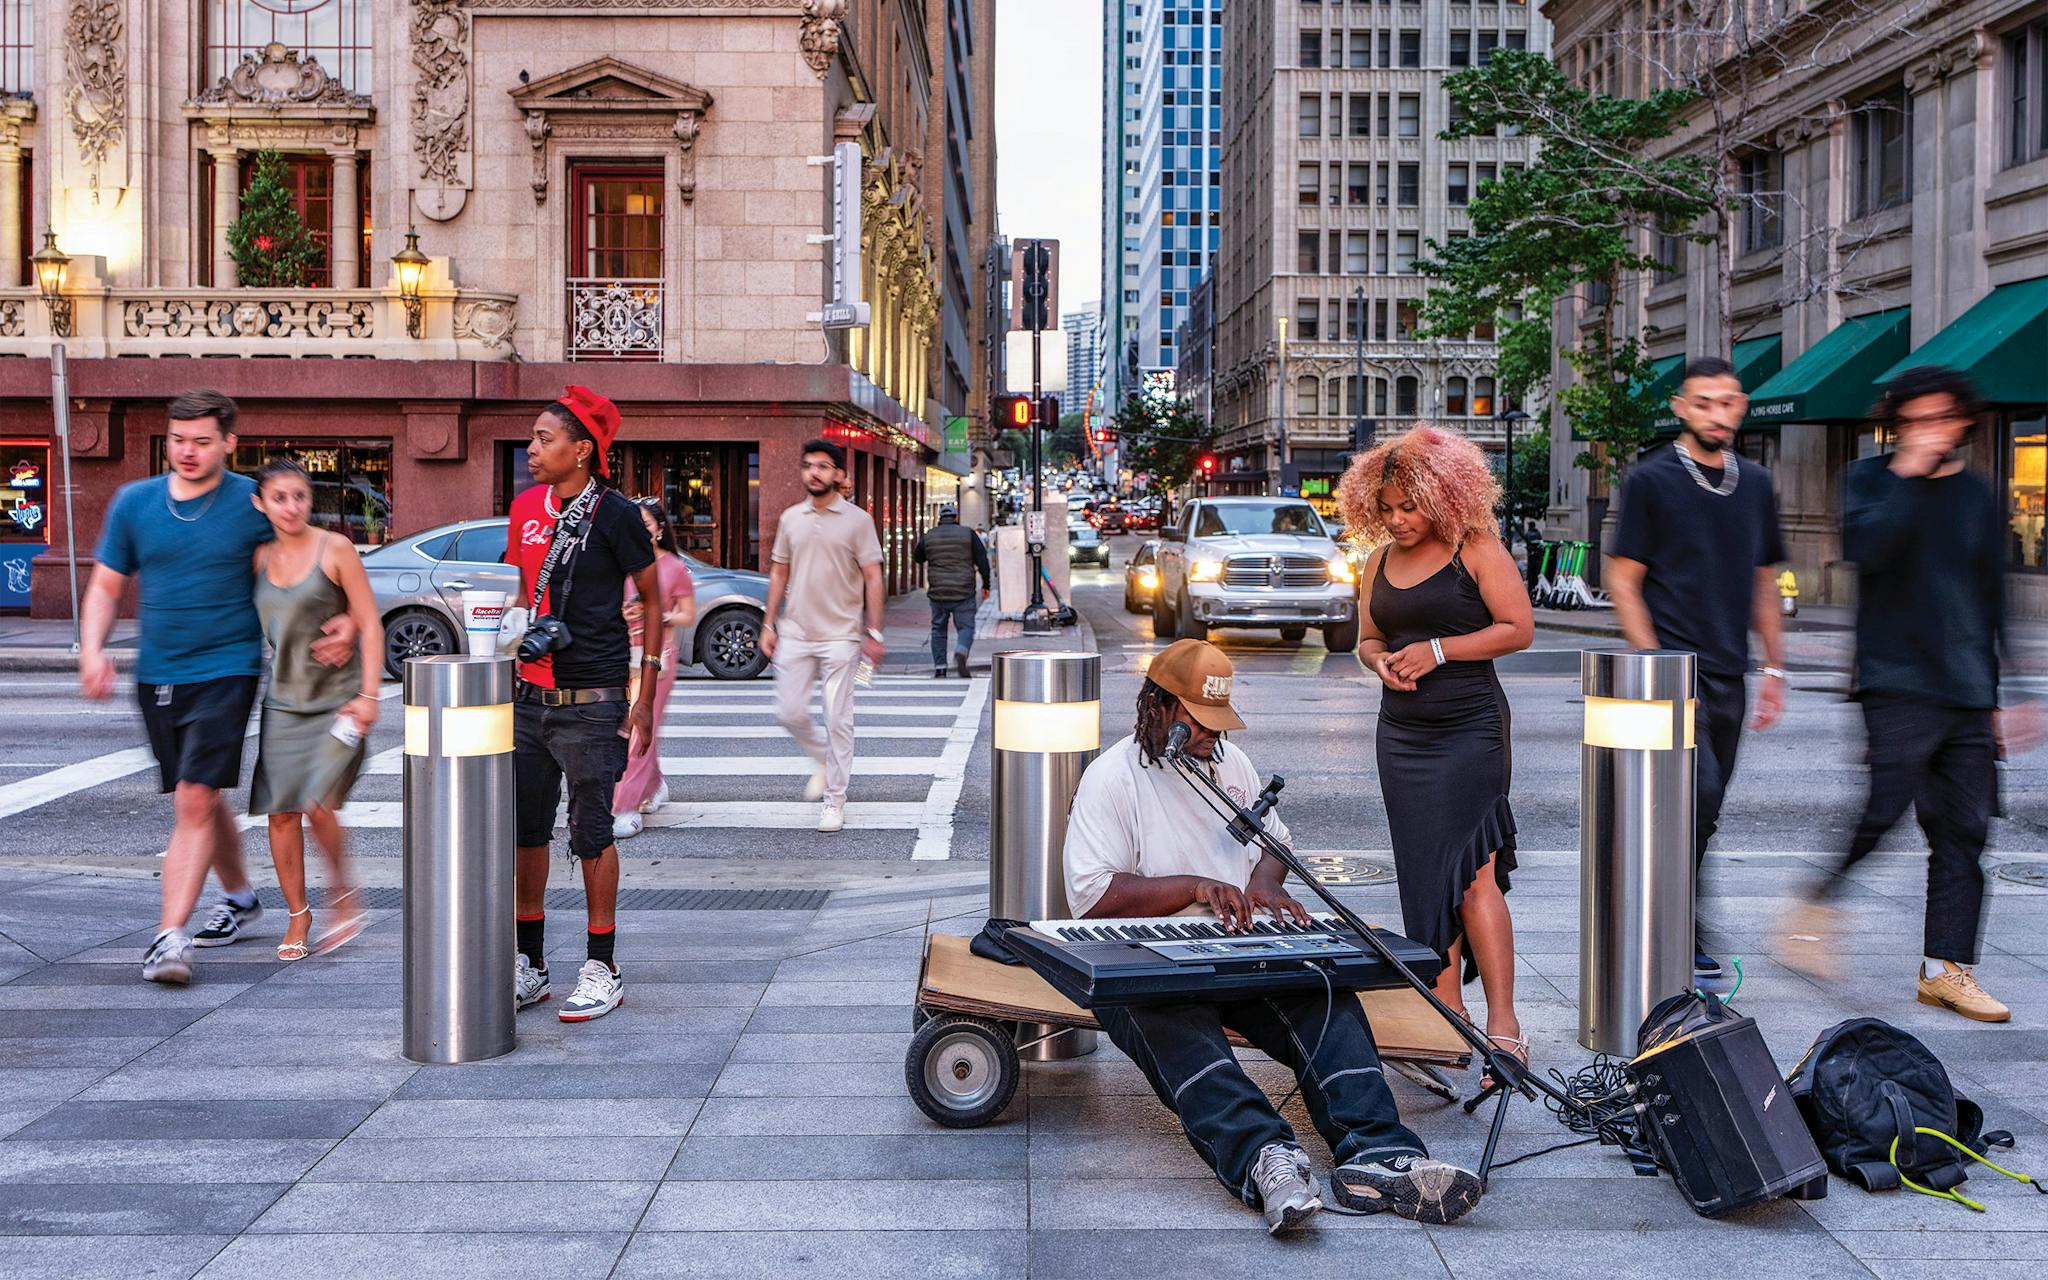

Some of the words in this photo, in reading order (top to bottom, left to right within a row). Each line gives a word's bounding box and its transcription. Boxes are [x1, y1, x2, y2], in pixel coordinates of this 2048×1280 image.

[1766, 403, 1781, 415] HORSE
[1781, 401, 1794, 414] CAFE
[1763, 1084, 1776, 1112] BOSE
